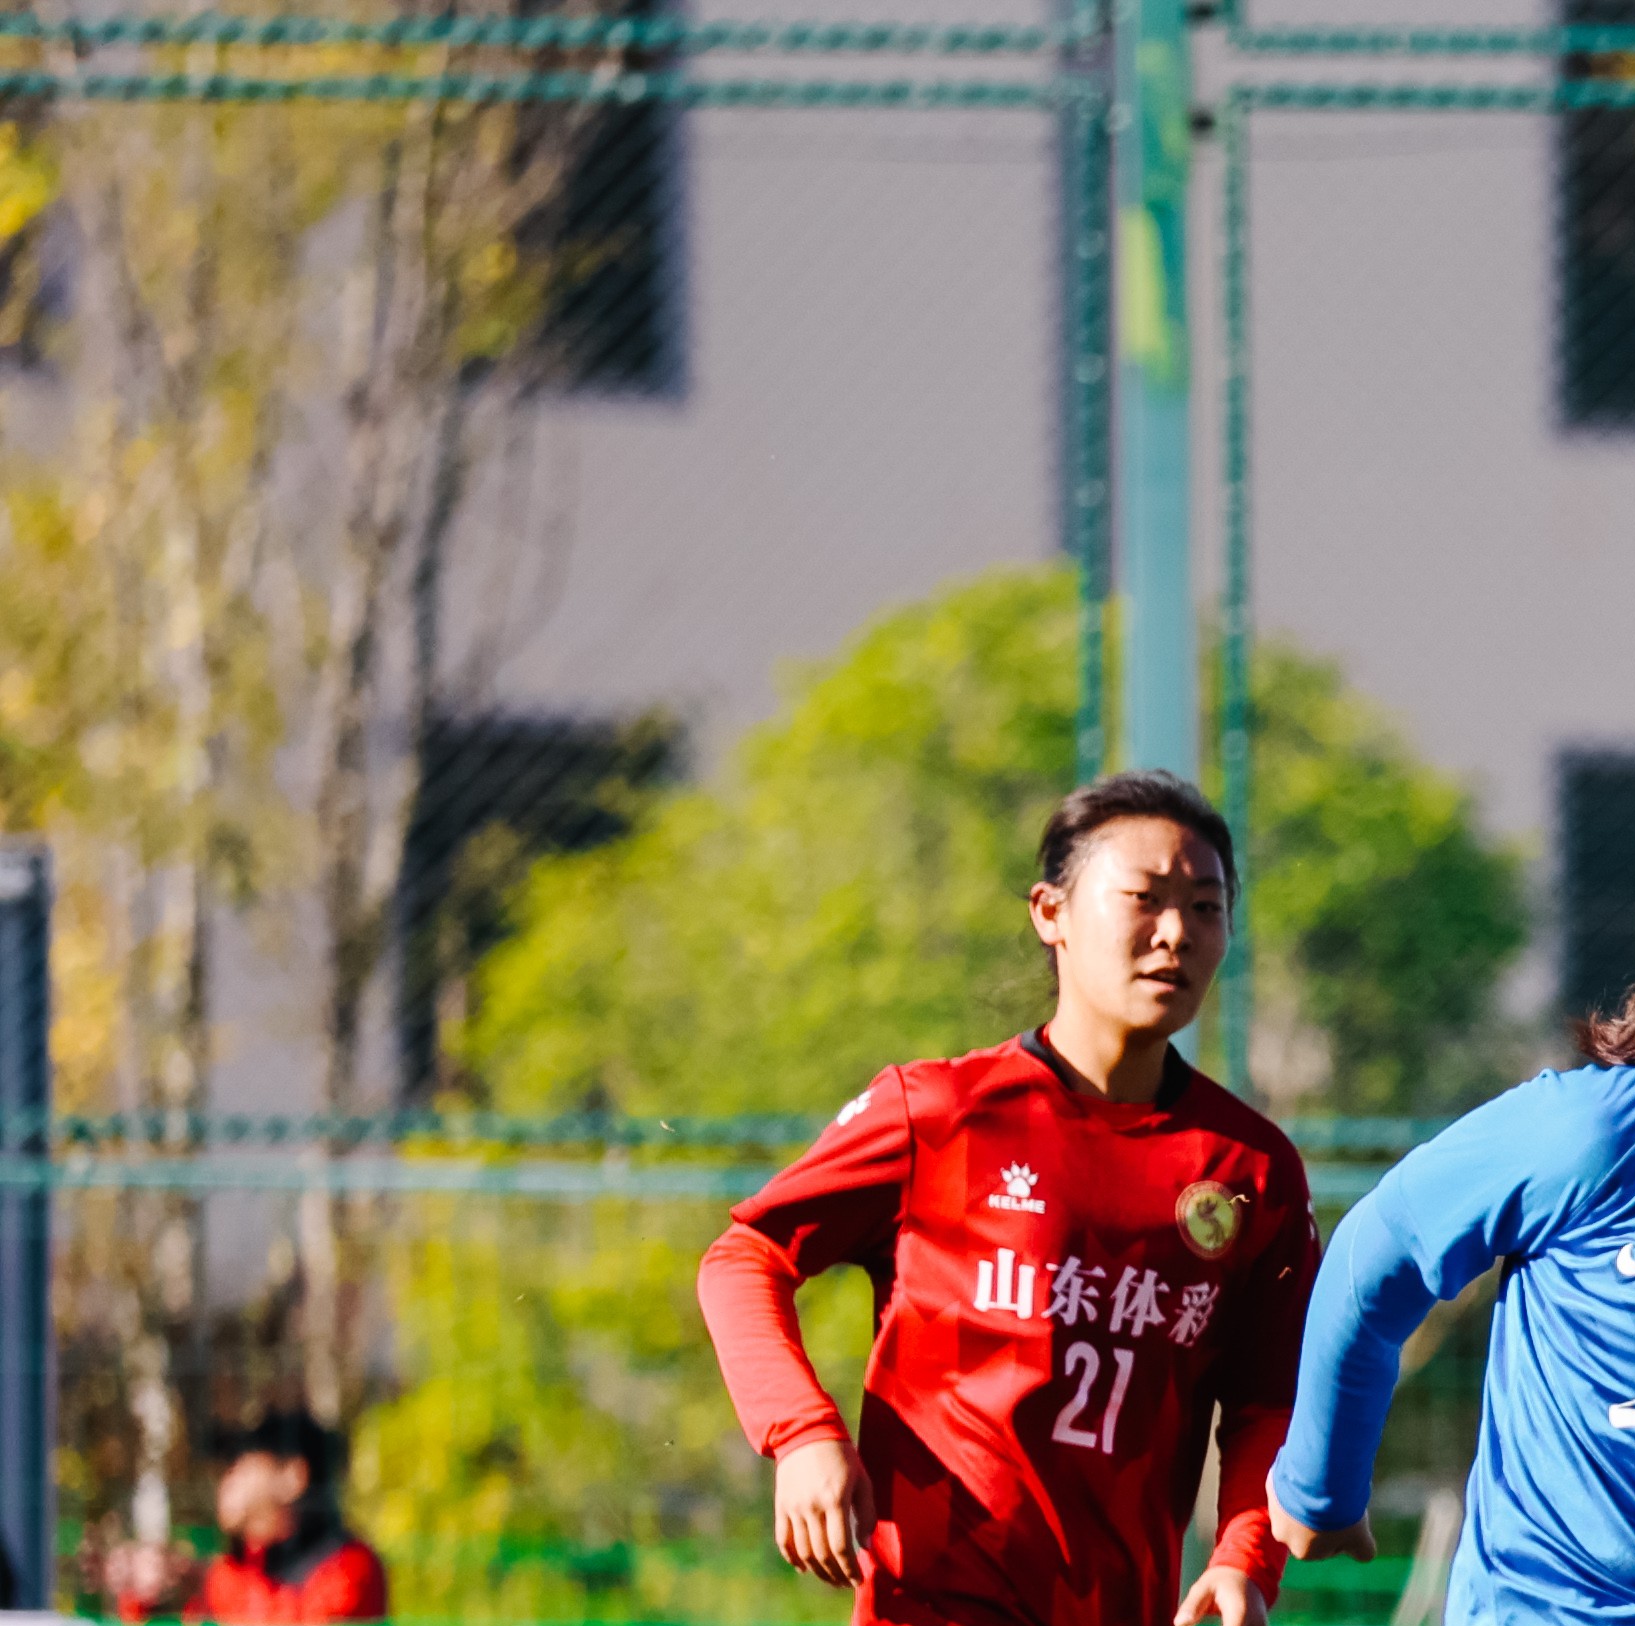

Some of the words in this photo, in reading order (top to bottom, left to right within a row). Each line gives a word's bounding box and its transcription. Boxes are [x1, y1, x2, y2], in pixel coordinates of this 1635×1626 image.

[988, 1193, 1046, 1215] KELME
[973, 1246, 1220, 1348] 山东体彩
[1051, 1340, 1135, 1455] 21
